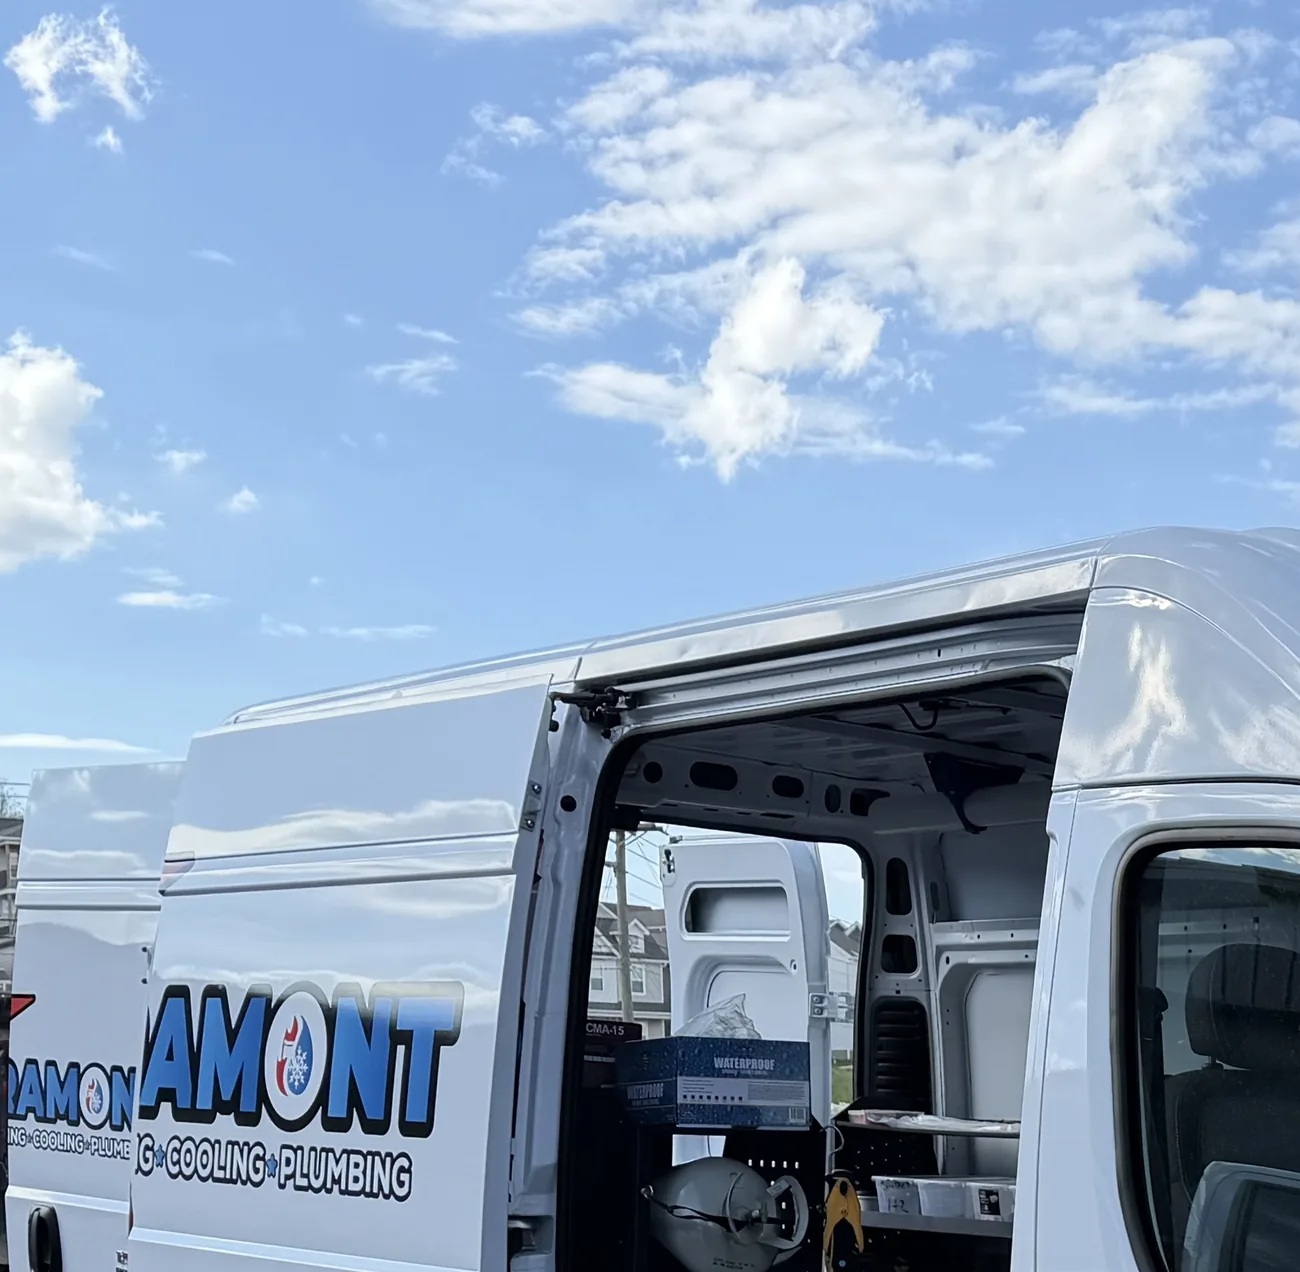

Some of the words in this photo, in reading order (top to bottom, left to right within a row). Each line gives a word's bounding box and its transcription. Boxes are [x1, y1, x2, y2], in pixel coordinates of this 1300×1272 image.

[586, 1023, 624, 1036] CMA-15
[714, 1056, 775, 1071] WATERPROOF
[32, 1129, 84, 1155] COOLING
[135, 1132, 155, 1177] G
[165, 1134, 266, 1188] COOLING
[277, 1143, 413, 1202] PLUMBING
